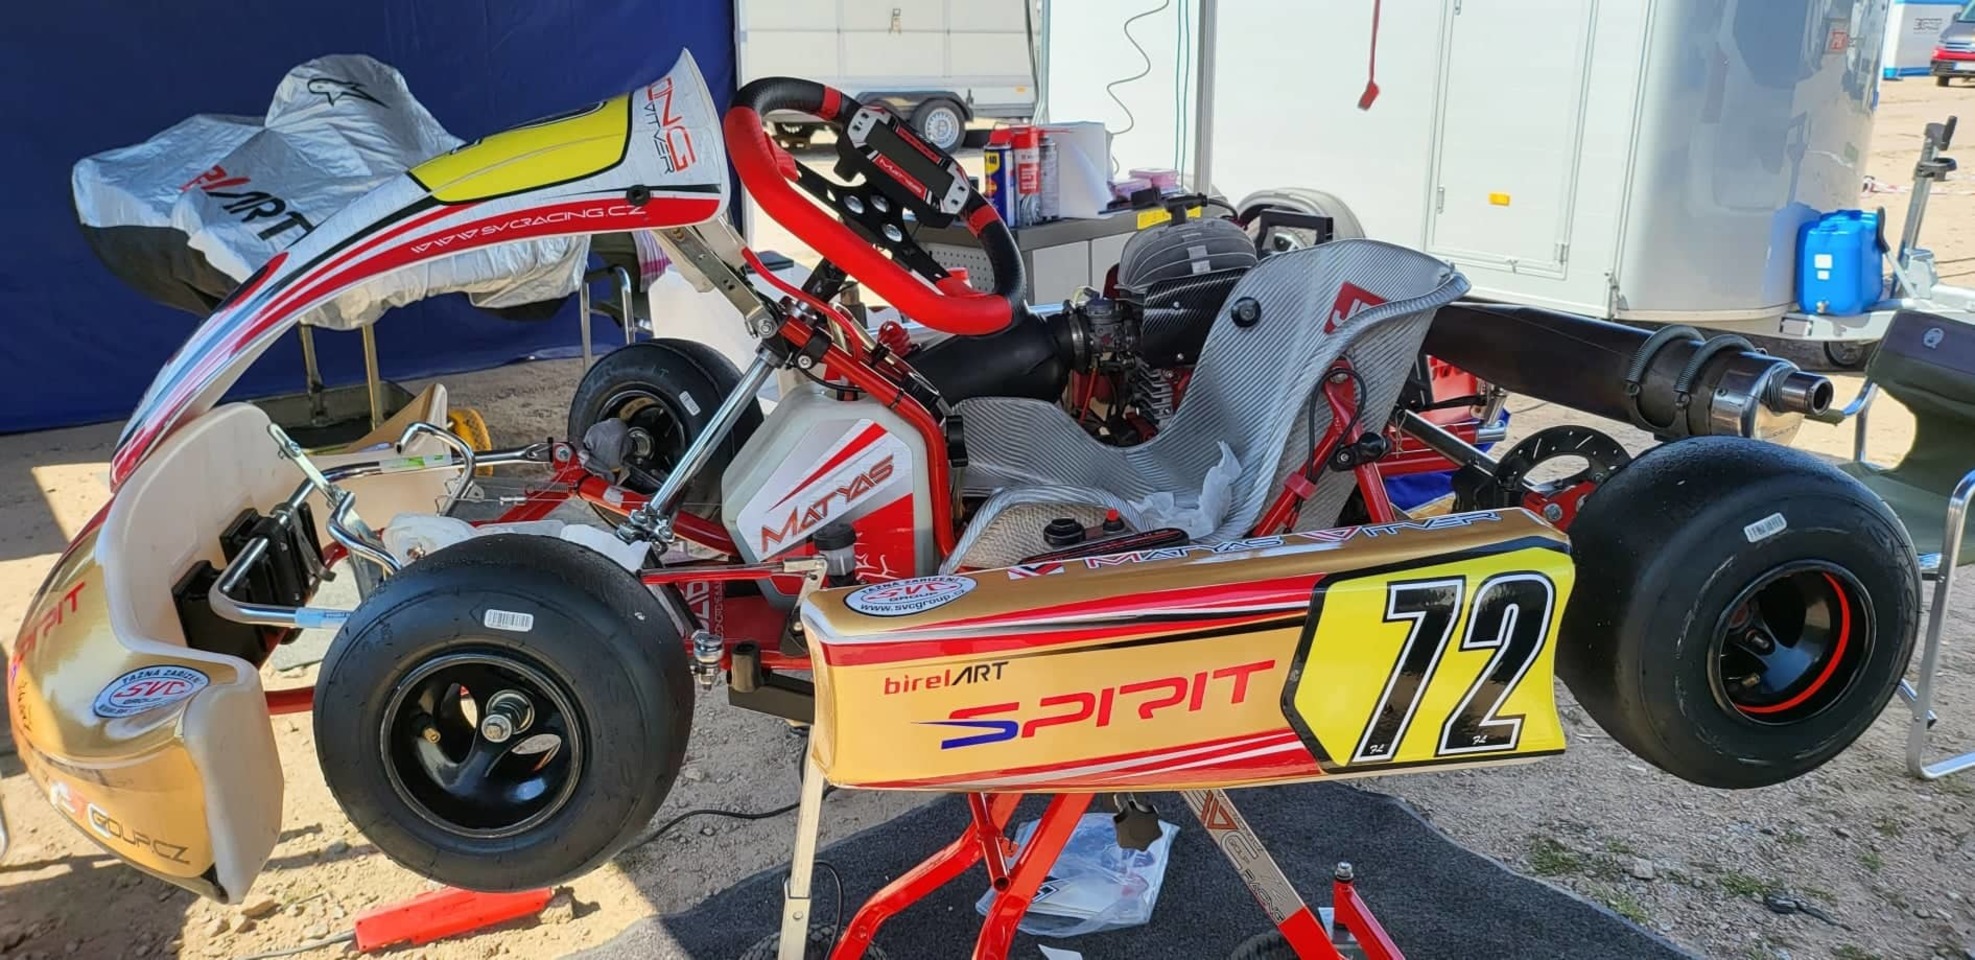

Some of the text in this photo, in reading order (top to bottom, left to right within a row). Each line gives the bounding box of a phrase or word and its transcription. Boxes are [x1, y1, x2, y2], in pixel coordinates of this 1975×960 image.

[761, 453, 894, 553] MATYAS
[113, 681, 185, 698] SVC
[884, 661, 1009, 695] birelART
[911, 660, 1275, 749] SPIRIT
[1351, 570, 1556, 762] 72
